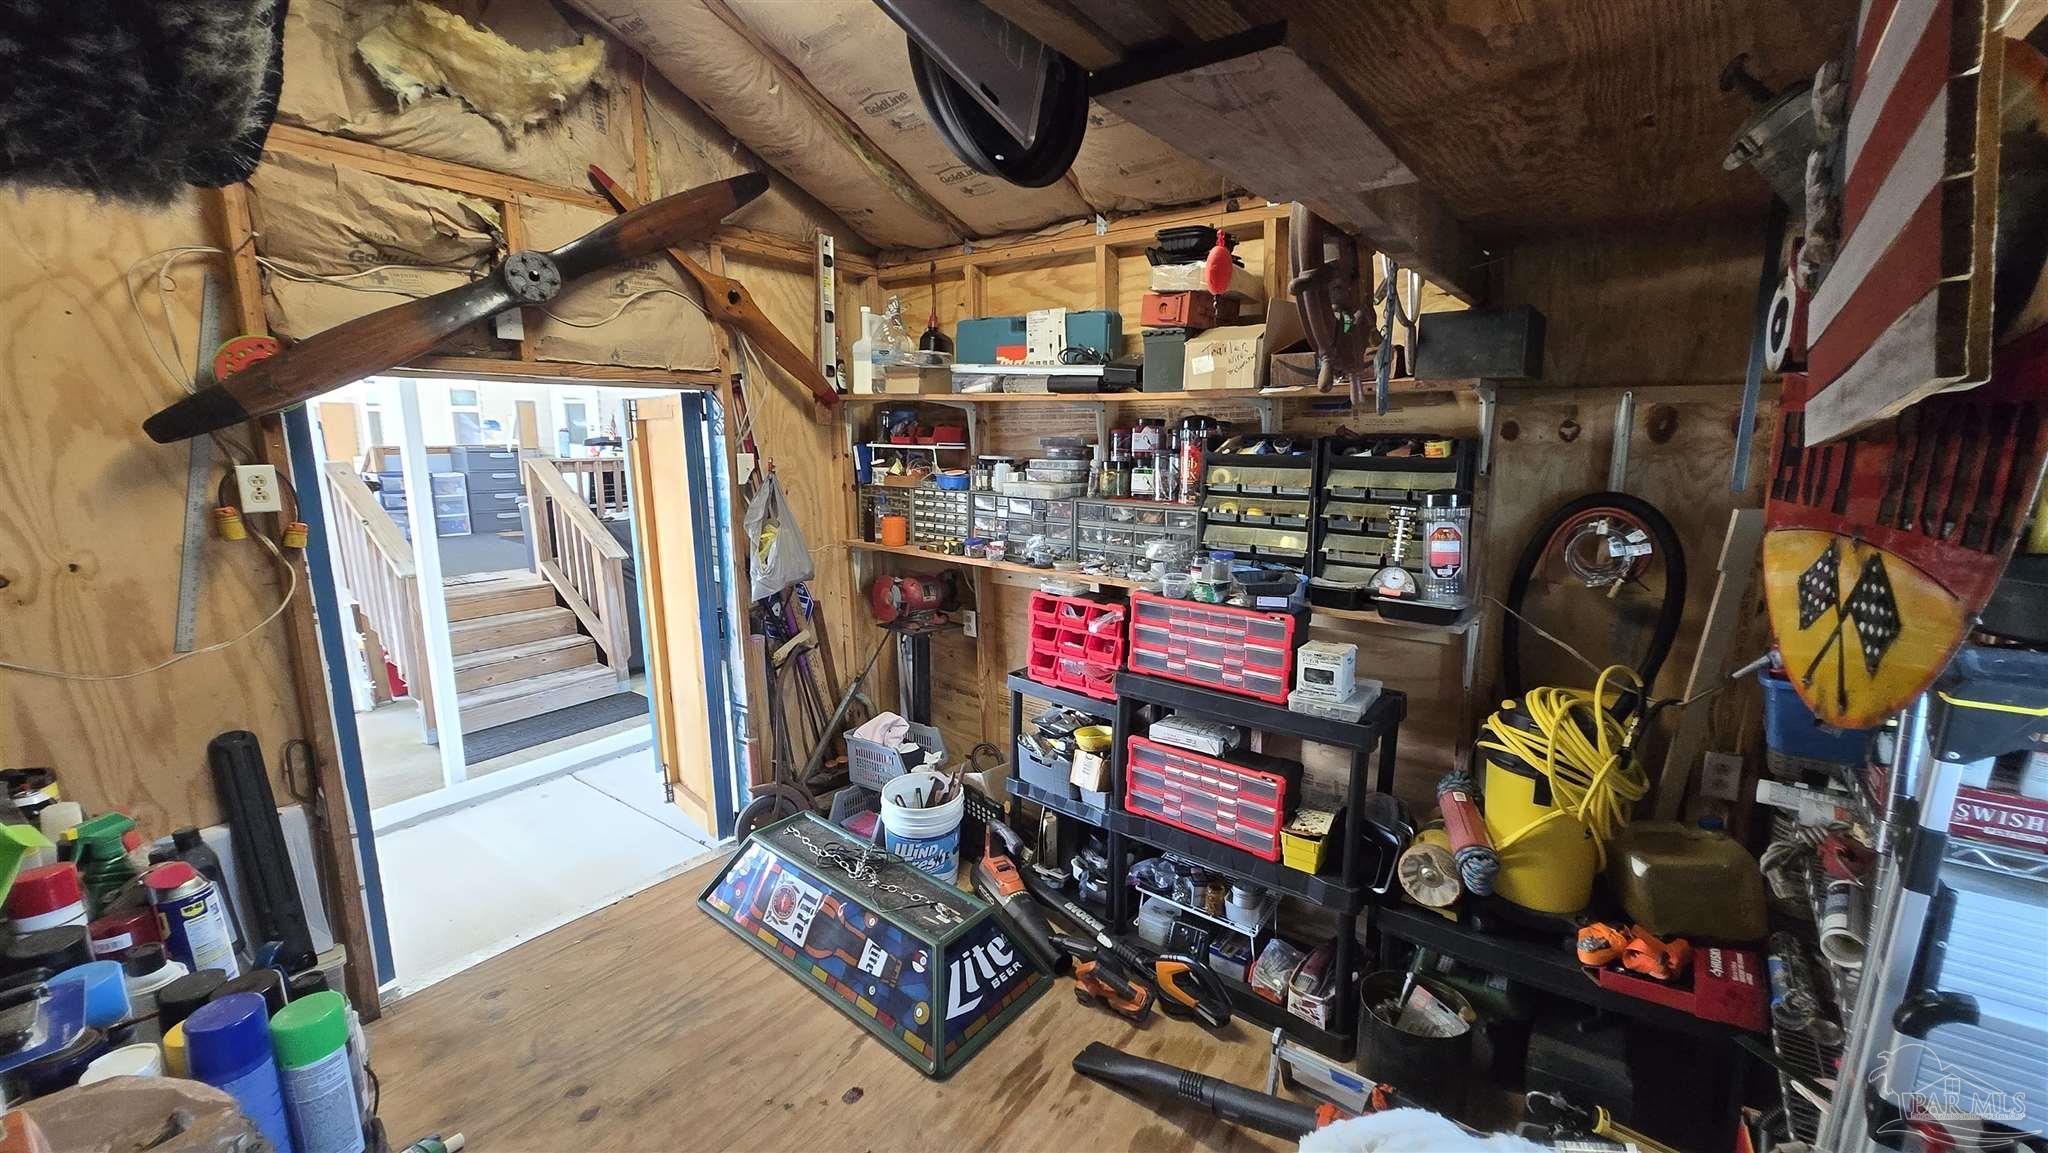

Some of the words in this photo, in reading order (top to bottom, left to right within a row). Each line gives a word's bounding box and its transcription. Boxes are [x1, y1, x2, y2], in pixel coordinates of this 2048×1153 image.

[863, 91, 909, 115] GoldLine
[940, 168, 977, 184] GoldLin
[792, 889, 820, 940] Lite
[865, 943, 883, 975] Lite
[944, 936, 1014, 1021] Lite
[991, 961, 1023, 990] BEER
